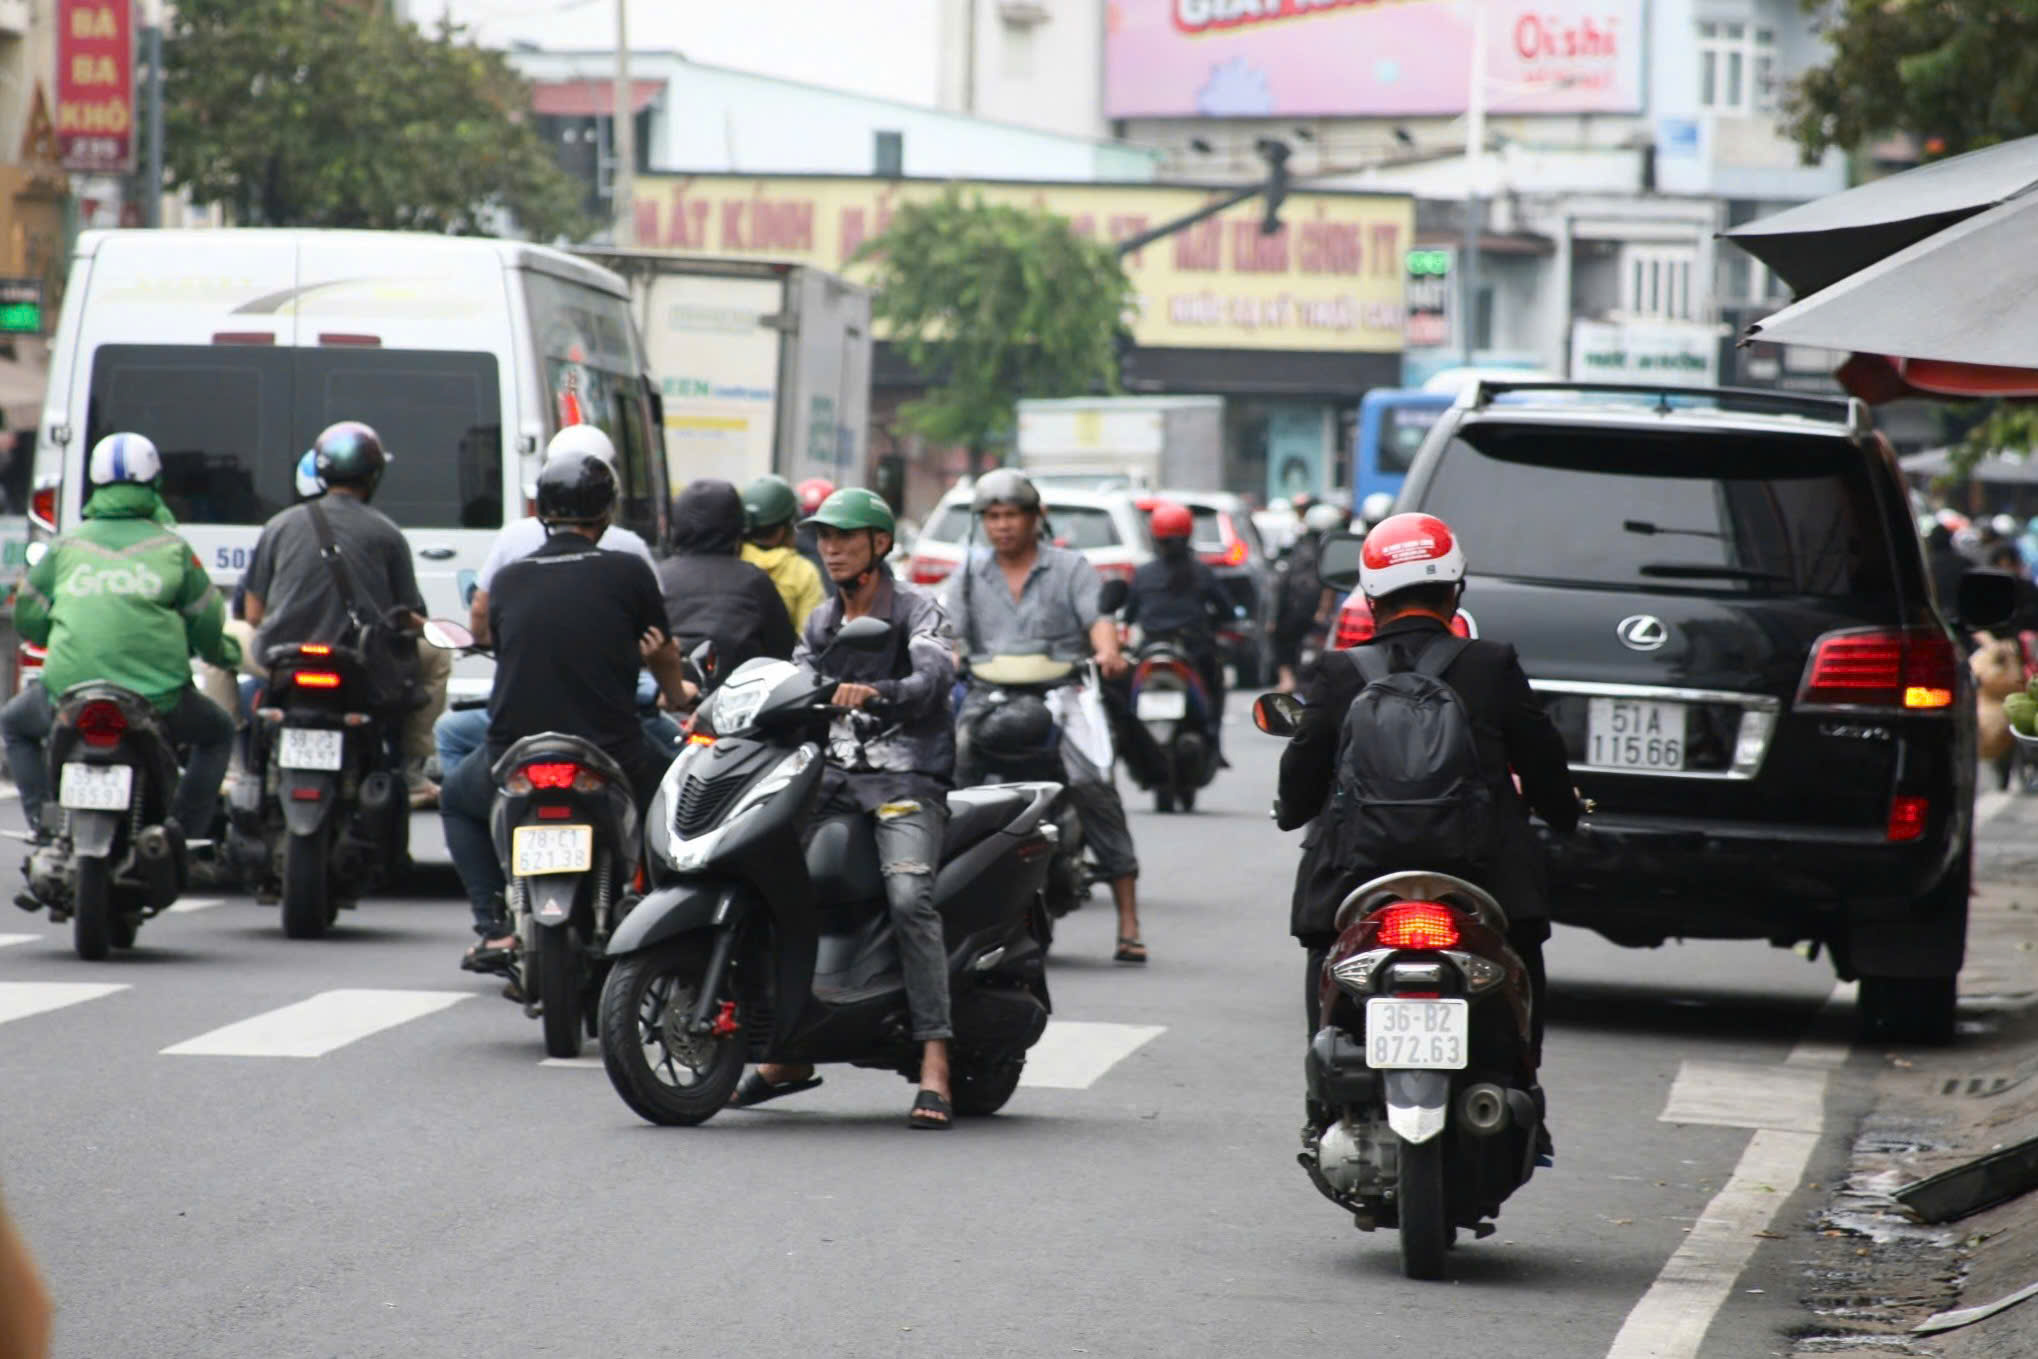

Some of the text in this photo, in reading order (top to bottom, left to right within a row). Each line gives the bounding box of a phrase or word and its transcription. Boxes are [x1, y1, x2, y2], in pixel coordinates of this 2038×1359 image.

[1514, 14, 1617, 59] Oishi
[69, 562, 163, 598] Grab
[1612, 704, 1662, 735] 51A
[1595, 735, 1680, 767] 115.66
[1383, 1004, 1452, 1032] 36-B2
[1375, 1035, 1460, 1063] 872.63
